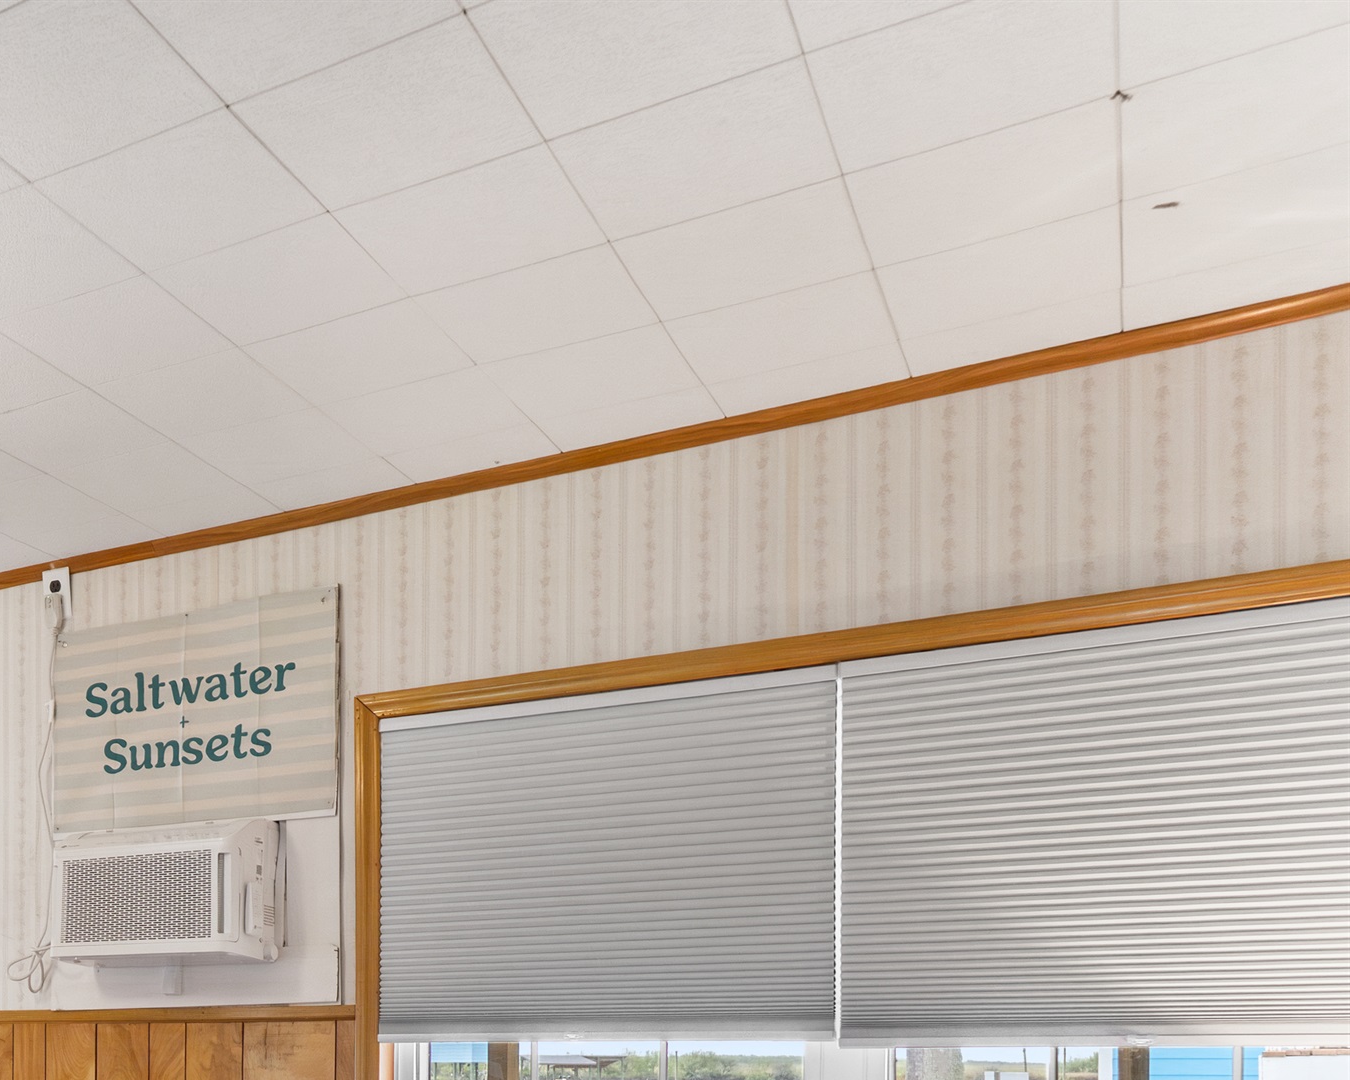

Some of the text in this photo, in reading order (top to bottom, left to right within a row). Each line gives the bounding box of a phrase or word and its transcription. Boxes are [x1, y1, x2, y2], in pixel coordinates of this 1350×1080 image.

[85, 662, 296, 718] Saltwater
[179, 715, 190, 729] +
[103, 724, 272, 775] Sunsets
